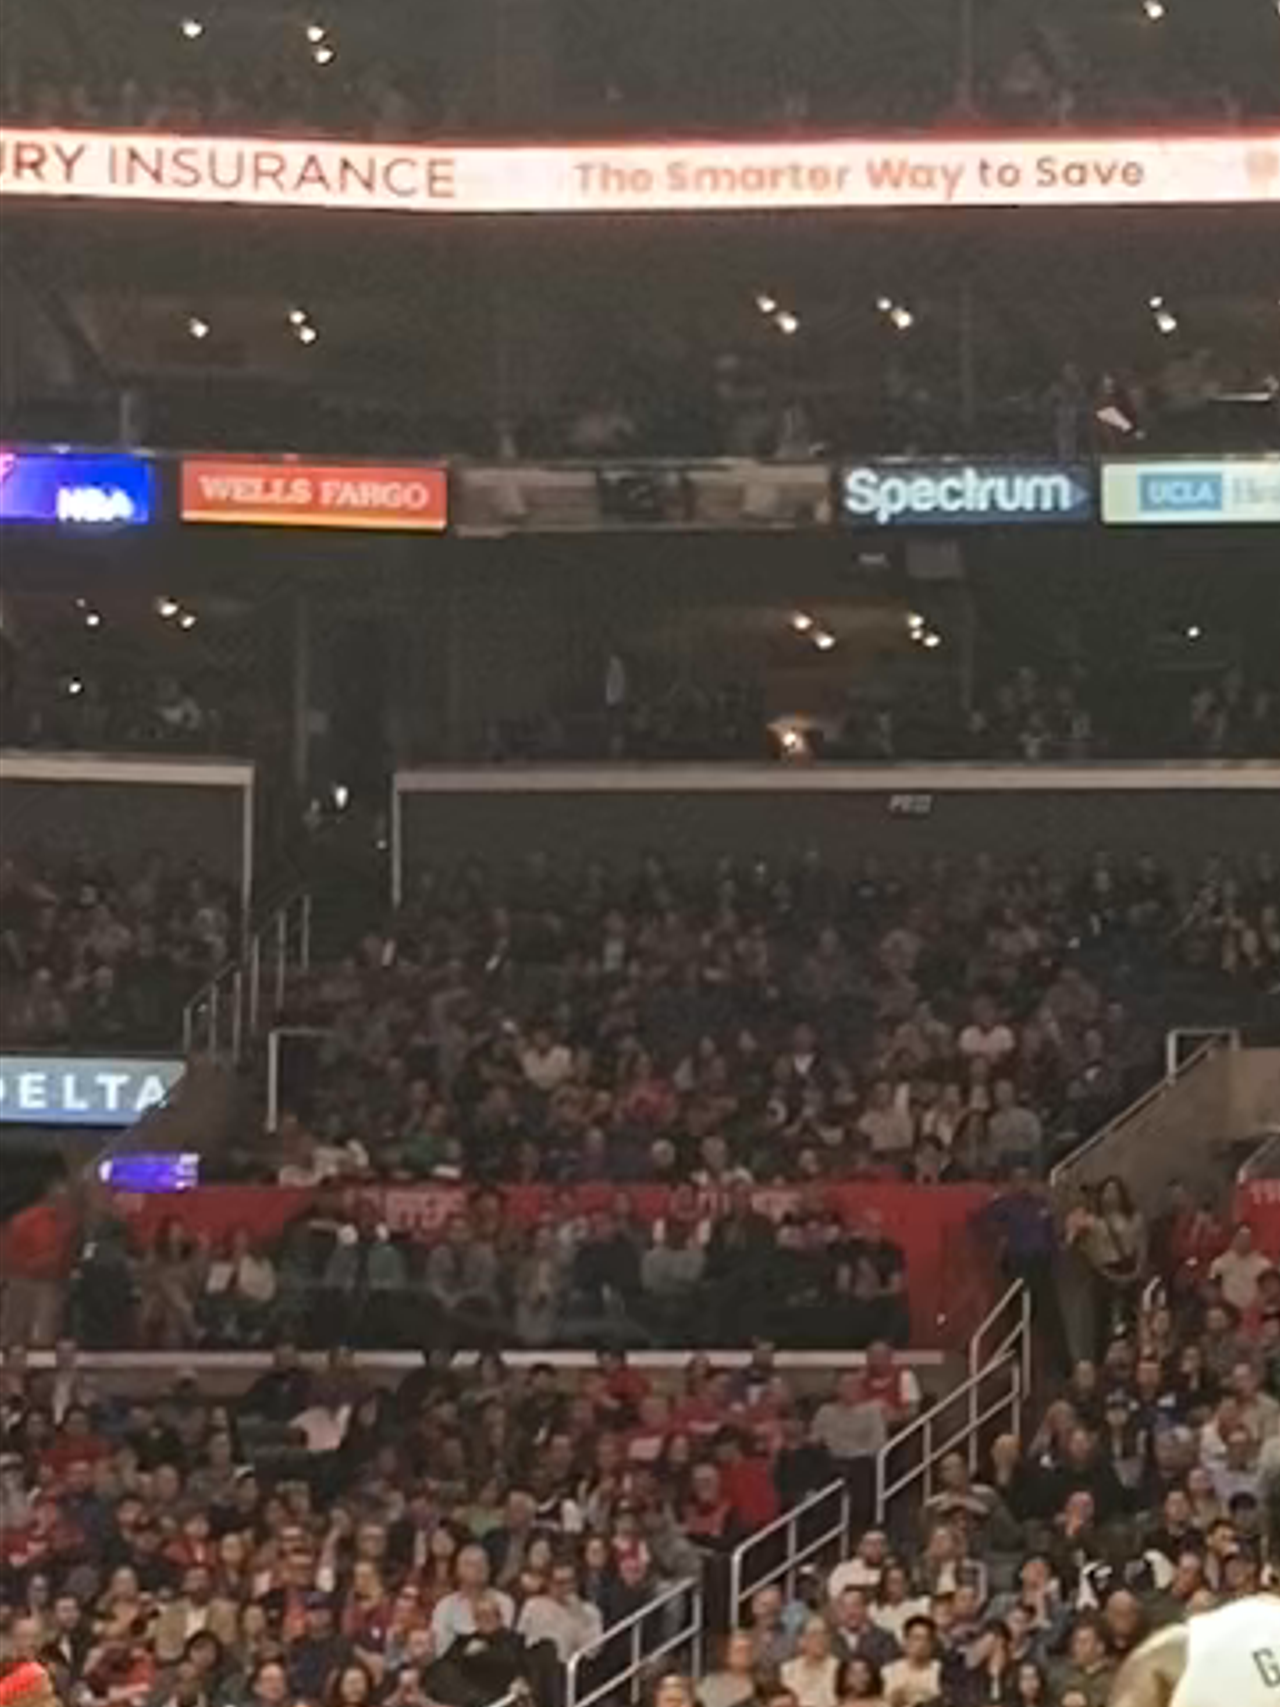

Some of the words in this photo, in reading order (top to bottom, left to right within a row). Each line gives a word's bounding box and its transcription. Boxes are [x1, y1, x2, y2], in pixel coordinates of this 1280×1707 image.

[0, 140, 87, 183] RY
[108, 146, 457, 199] INSURANCE
[574, 160, 652, 195] The
[666, 158, 850, 193] Smarter
[865, 156, 964, 200] Way
[978, 156, 1021, 188] to
[1035, 154, 1146, 189] Save
[198, 474, 313, 506] WELLS
[320, 478, 430, 512] FARGO
[843, 467, 1072, 526] Spectrum
[1146, 480, 1216, 506] UCLA
[0, 1072, 168, 1112] ELTA
